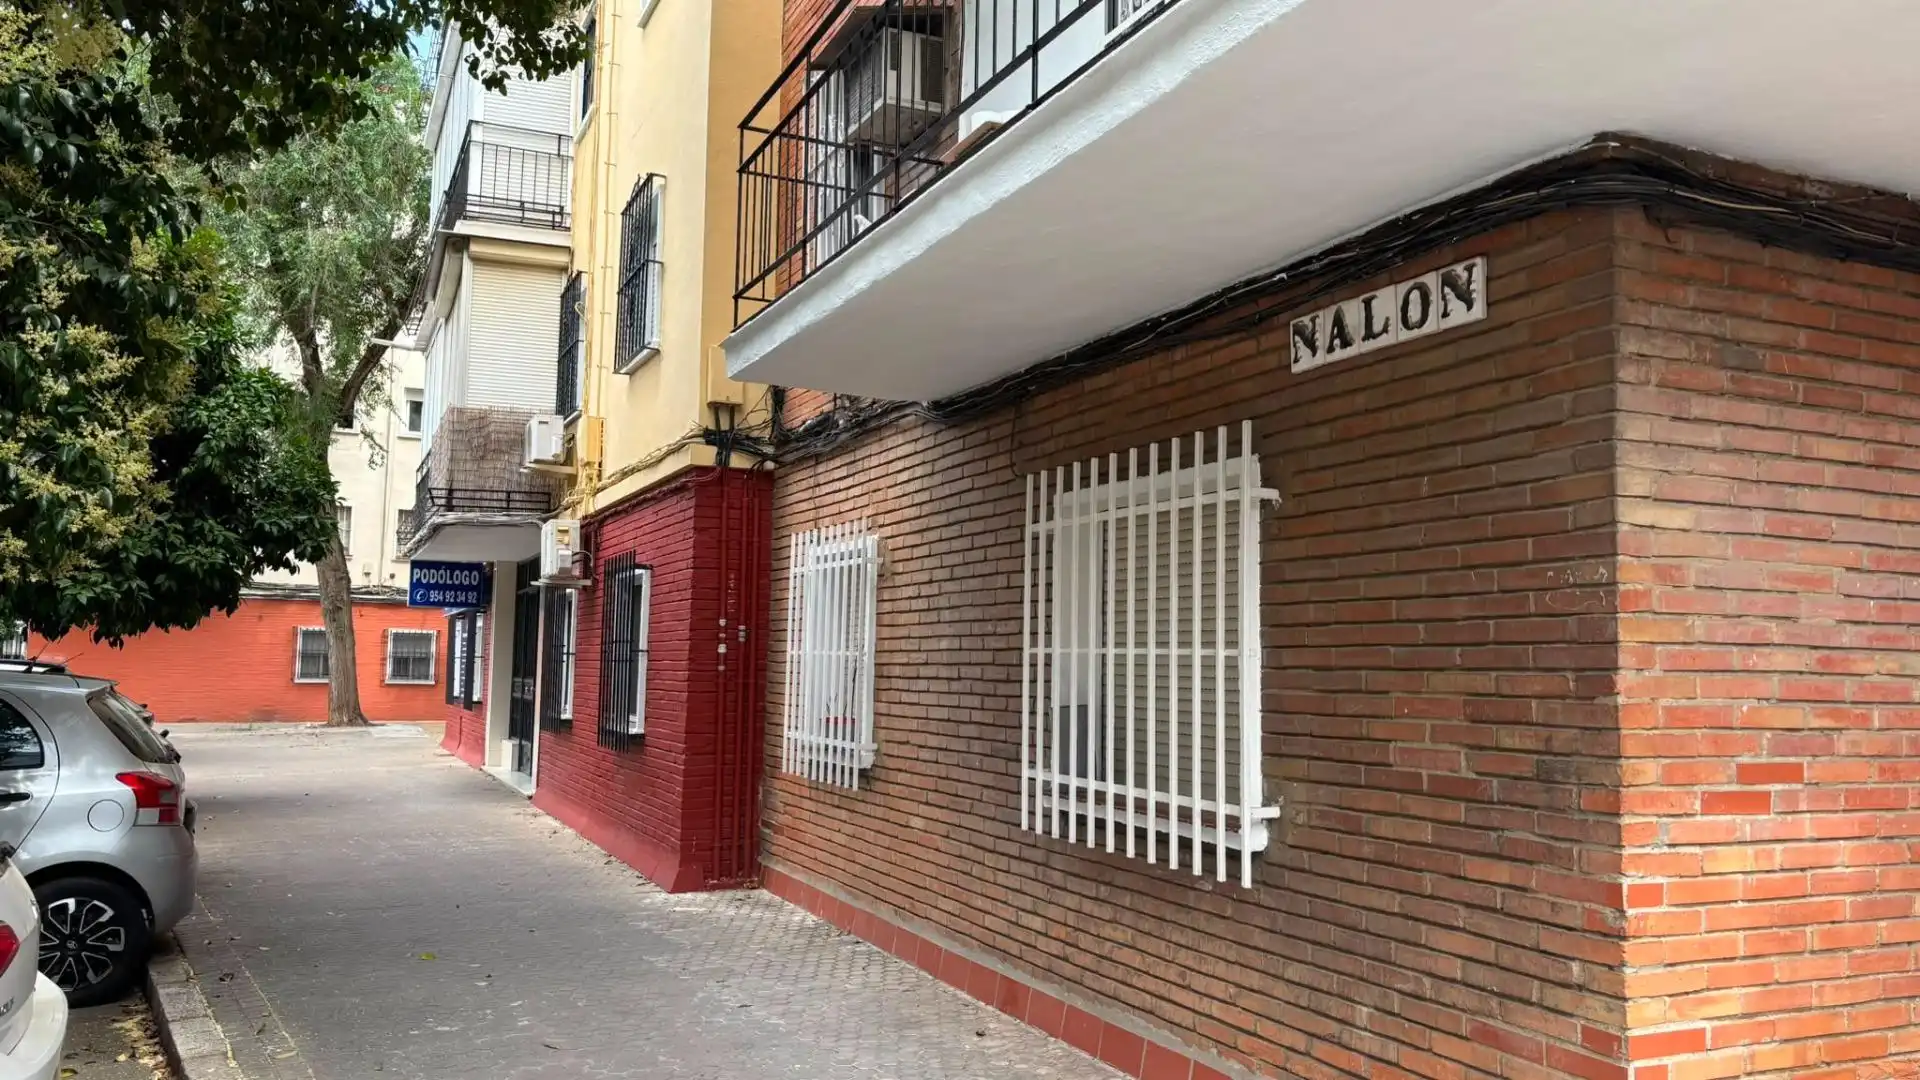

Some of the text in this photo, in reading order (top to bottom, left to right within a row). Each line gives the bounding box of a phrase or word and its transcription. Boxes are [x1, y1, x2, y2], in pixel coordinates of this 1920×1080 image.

[1292, 262, 1477, 364] NALON
[413, 566, 479, 585] PODÓLOGO
[429, 590, 444, 602] 954
[445, 591, 455, 603] 92
